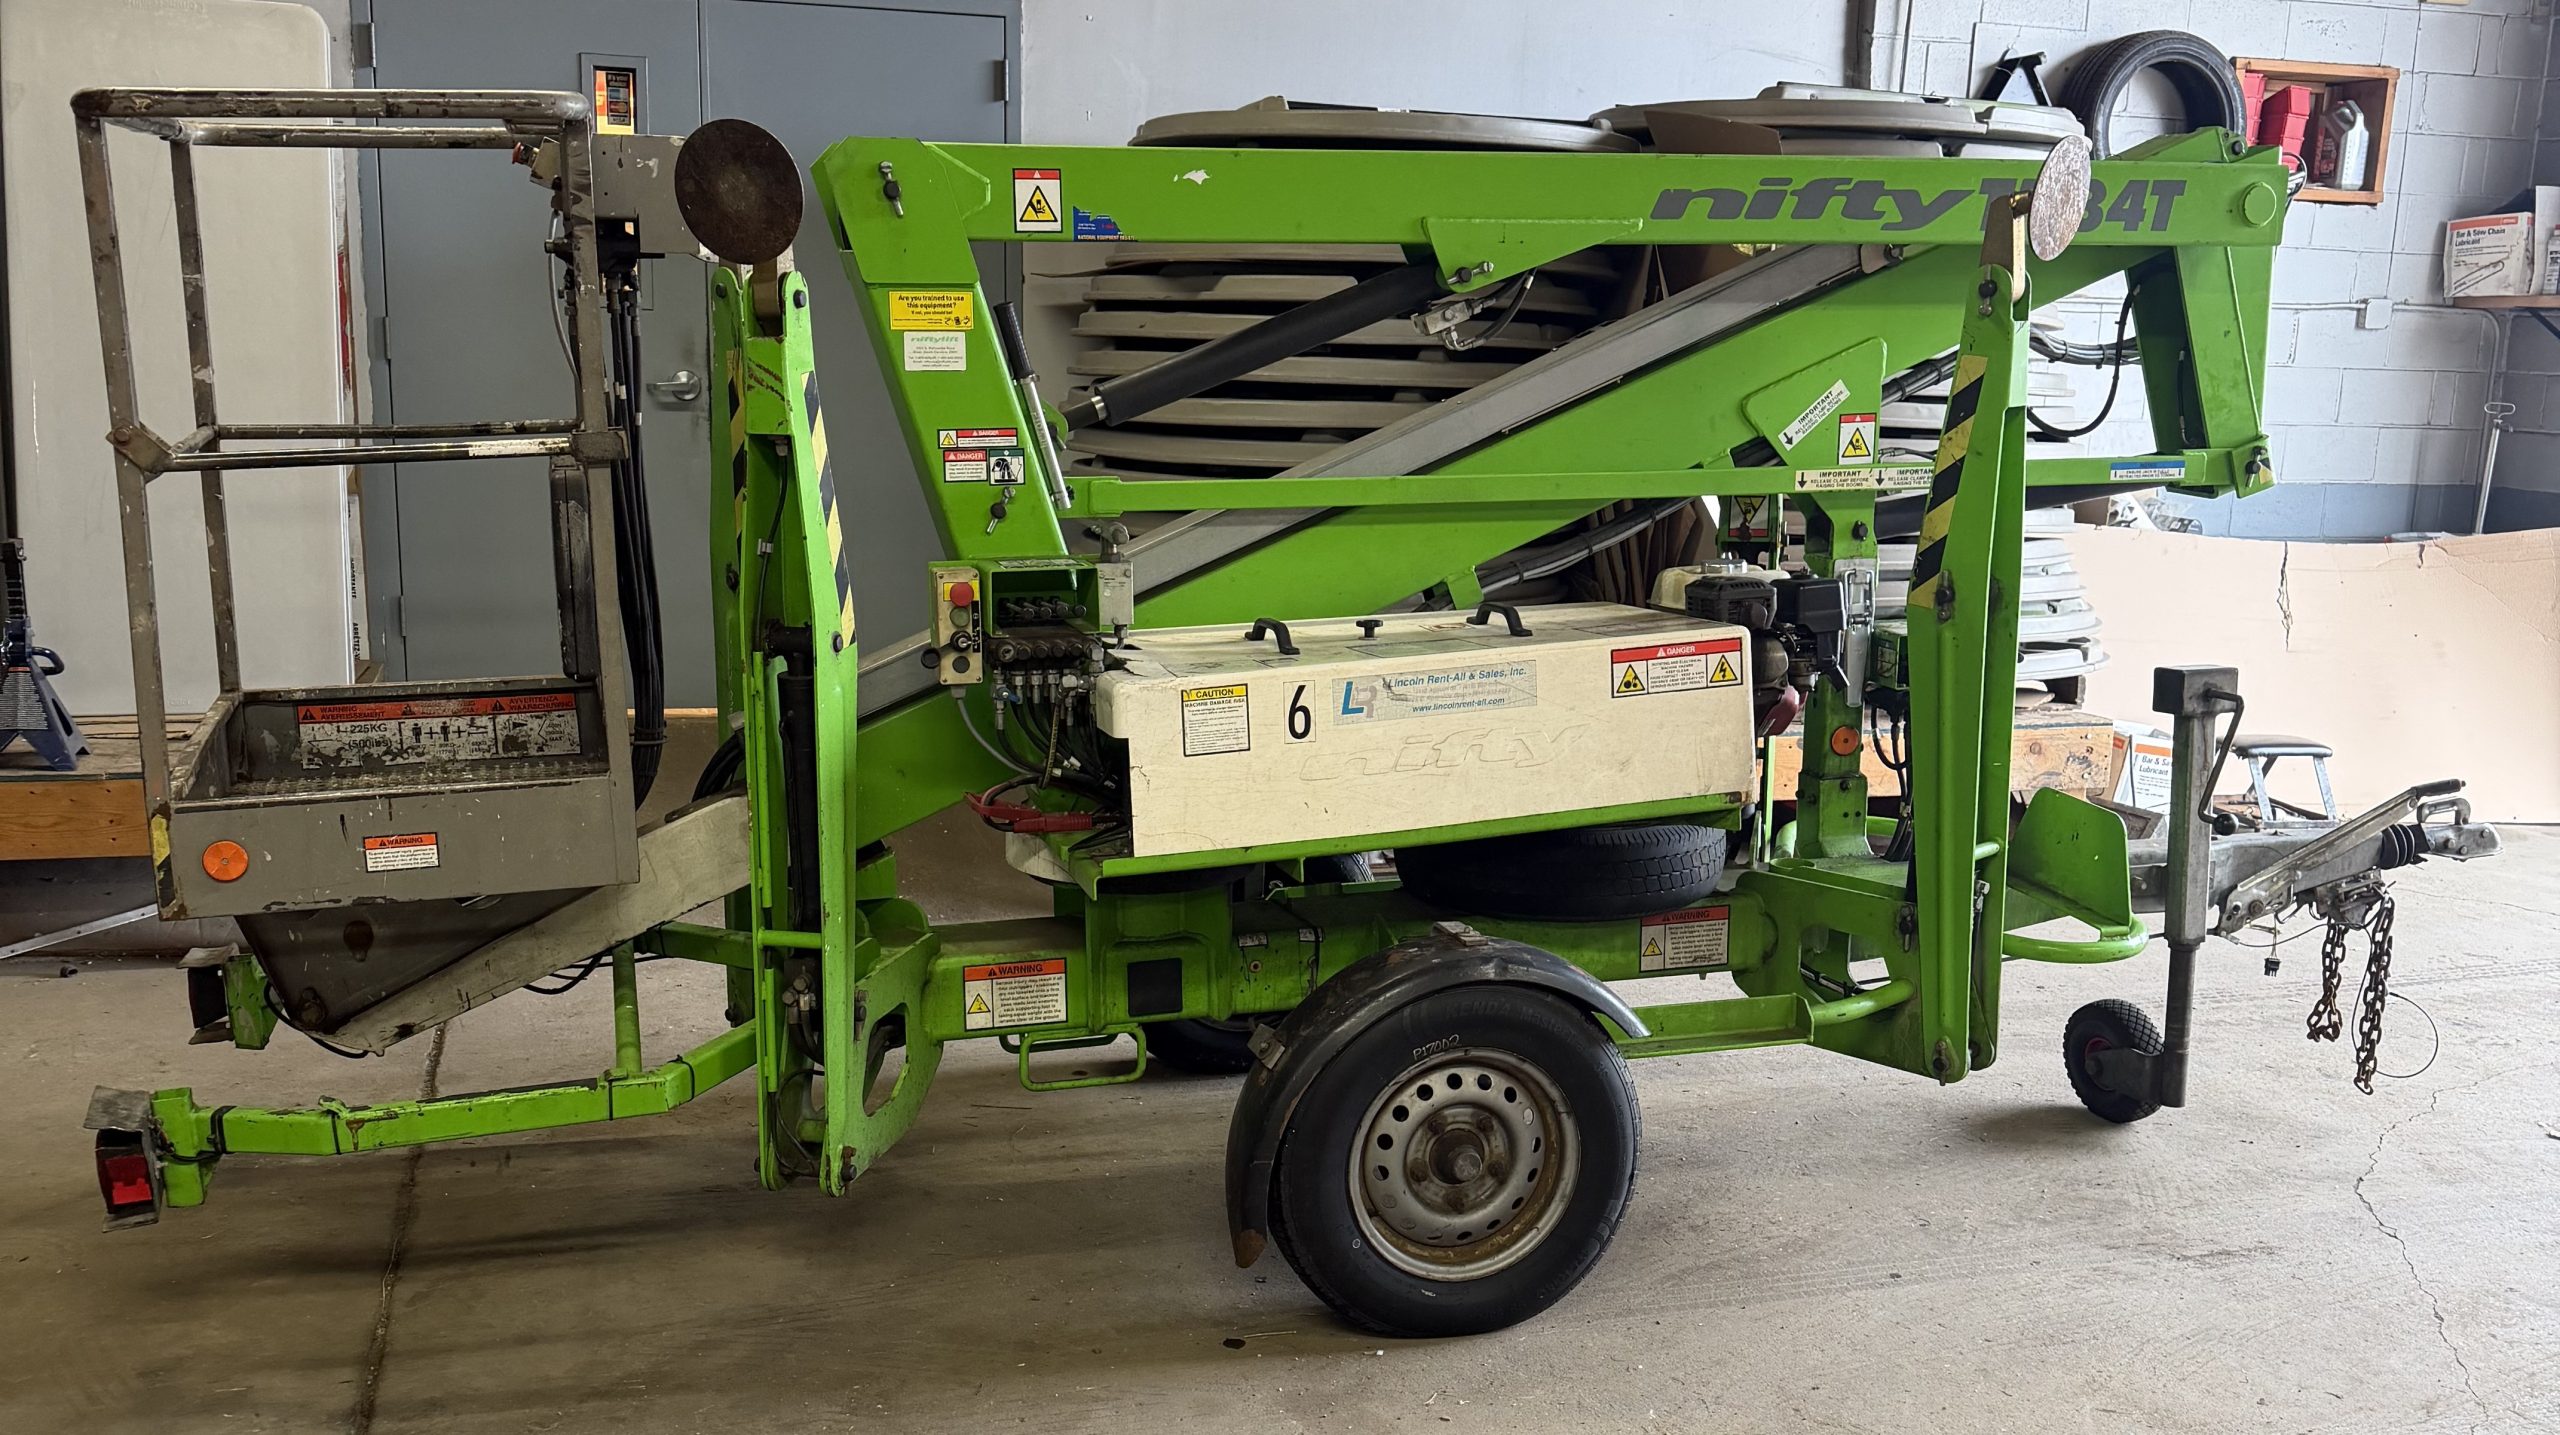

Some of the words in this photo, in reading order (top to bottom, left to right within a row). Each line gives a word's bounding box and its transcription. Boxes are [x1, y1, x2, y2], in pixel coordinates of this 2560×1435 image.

[1649, 177, 1976, 232] nifty
[1981, 178, 2187, 233] T34T
[1798, 390, 1833, 424] IMPORTANT
[1795, 418, 1814, 435] RELEASE
[1814, 403, 1828, 420] CLAMP
[1828, 391, 1844, 407] BEFORE
[1667, 646, 1696, 655] DANGER
[1388, 676, 1425, 688] Lincoln
[1428, 672, 1466, 686] Rent-All
[1478, 669, 1507, 680] Sales,
[1510, 667, 1527, 676] Inc.
[1196, 688, 1234, 698] CAUTION
[1412, 697, 1505, 713] www.lincolnrent-all.com
[1288, 684, 1312, 740] 6
[351, 723, 388, 734] 225KG
[2142, 755, 2152, 763] Bar
[2139, 766, 2168, 776] Lubricant
[1672, 911, 1710, 920] WARNING
[999, 964, 1043, 975] WARNING
